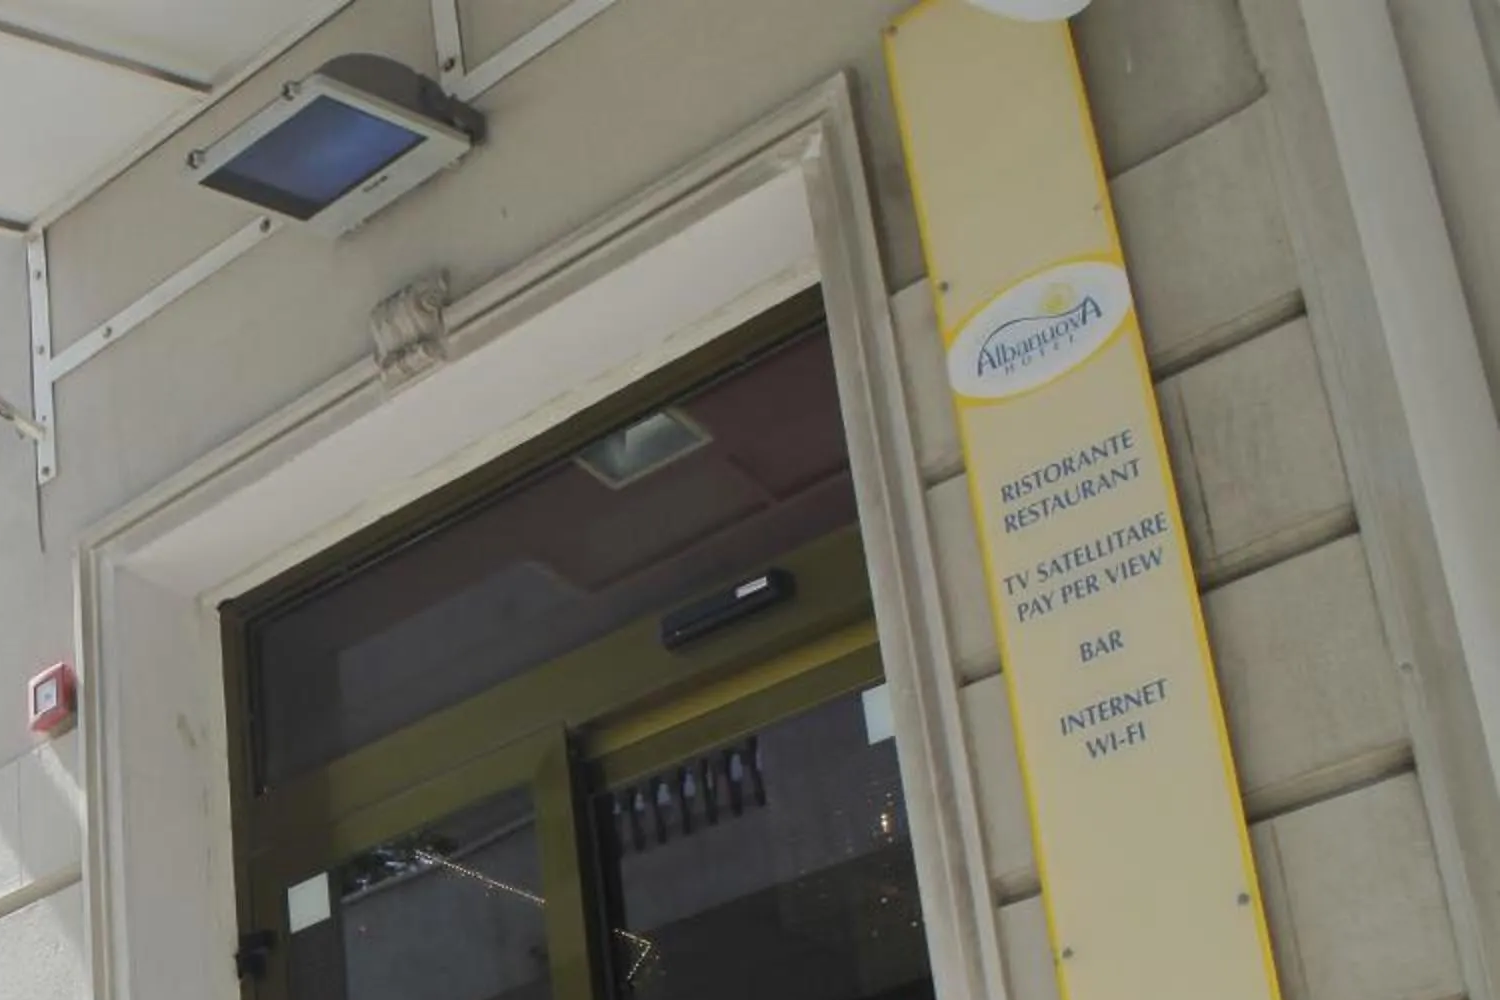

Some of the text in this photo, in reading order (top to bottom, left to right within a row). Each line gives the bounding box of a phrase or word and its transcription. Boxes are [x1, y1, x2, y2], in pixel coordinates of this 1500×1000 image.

[1000, 428, 1136, 504] RISTORANTE
[1004, 458, 1143, 533] RESTAURANT
[1003, 511, 1169, 596] TV SATELLITARE
[1017, 547, 1164, 623] PAY PER VIEW
[1079, 629, 1125, 663] BAR
[1060, 678, 1170, 736] INTERNET
[1085, 721, 1147, 759] WI-FI
